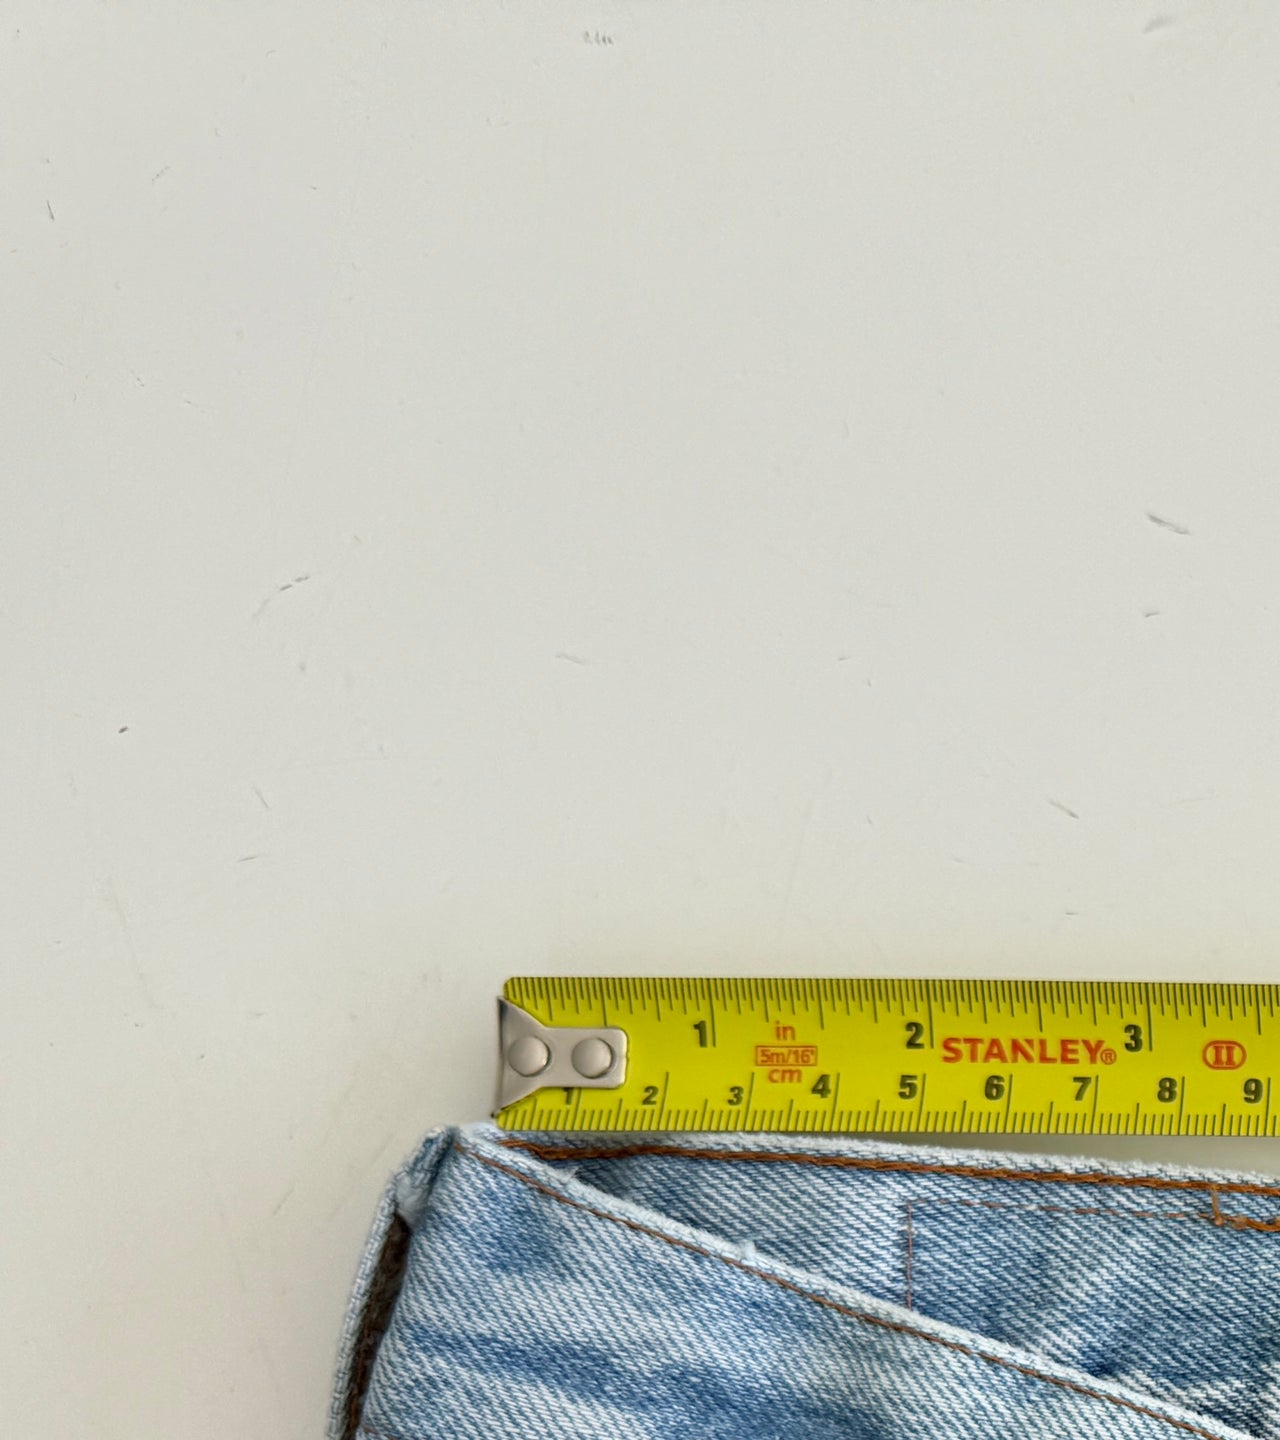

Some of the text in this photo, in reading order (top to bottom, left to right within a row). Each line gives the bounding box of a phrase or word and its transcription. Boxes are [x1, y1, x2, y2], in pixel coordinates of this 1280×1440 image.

[693, 1020, 708, 1048] 1
[905, 1022, 925, 1049] 2
[1124, 1024, 1143, 1052] 3
[775, 1020, 796, 1041] in
[768, 1067, 803, 1084] cm
[642, 1086, 659, 1106] 2
[727, 1086, 744, 1106] 3
[812, 1074, 831, 1098] 4
[899, 1075, 918, 1100] 5
[984, 1075, 1005, 1100] 6
[1073, 1076, 1092, 1101] 7
[1157, 1077, 1178, 1103] 8
[1243, 1078, 1263, 1104] 9
